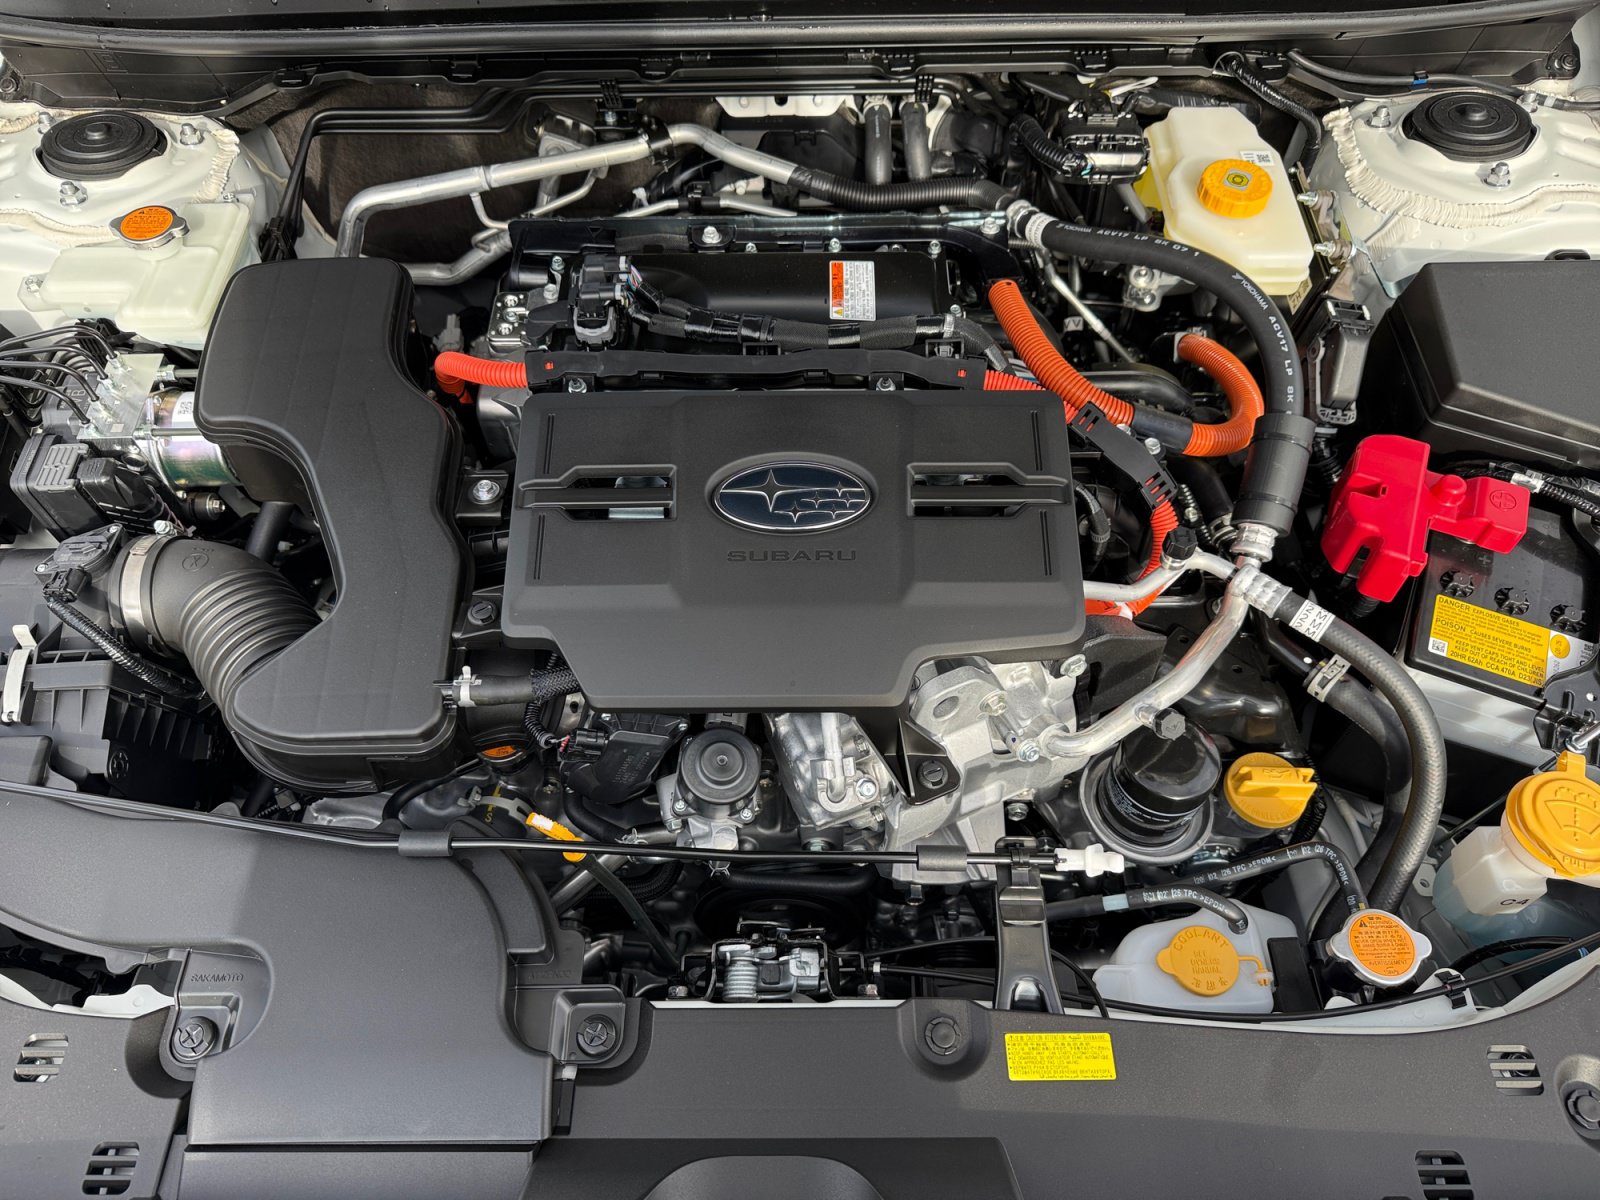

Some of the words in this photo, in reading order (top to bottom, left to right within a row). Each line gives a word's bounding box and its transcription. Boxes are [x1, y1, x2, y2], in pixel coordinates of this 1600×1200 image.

[1241, 279, 1269, 310] YOKOHAMA
[1284, 360, 1293, 376] LP
[727, 550, 857, 562] SUBARU
[1438, 597, 1471, 612] DANGER
[1472, 609, 1501, 621] EXPLOSIVE
[1501, 617, 1520, 627] GASES
[1435, 618, 1467, 633] POISON
[1469, 629, 1491, 640] CAUSES
[1492, 636, 1513, 648] SEVERE
[1513, 643, 1532, 653] BURNS
[1450, 650, 1467, 661] 20HR
[1486, 662, 1501, 672] CCA
[1501, 667, 1516, 676] 470A
[1454, 645, 1468, 654] KEEP
[1469, 650, 1480, 658] OUT
[1489, 655, 1508, 666] REACH
[1516, 664, 1544, 678] CHILDREN
[1455, 640, 1469, 648] KEEP
[1470, 644, 1484, 653] VENT
[1484, 649, 1499, 658] CAPS
[1500, 653, 1515, 664] TIGHT
[1515, 658, 1527, 667] AND
[1528, 662, 1545, 673] LEVEL
[1325, 848, 1337, 860] TPC
[1562, 855, 1591, 870] PULL
[1232, 863, 1247, 873] TPC
[1183, 888, 1198, 899] TPC
[1500, 898, 1530, 906] C4
[1173, 928, 1229, 951] COOLANT
[191, 973, 244, 982] SAKAMOTO
